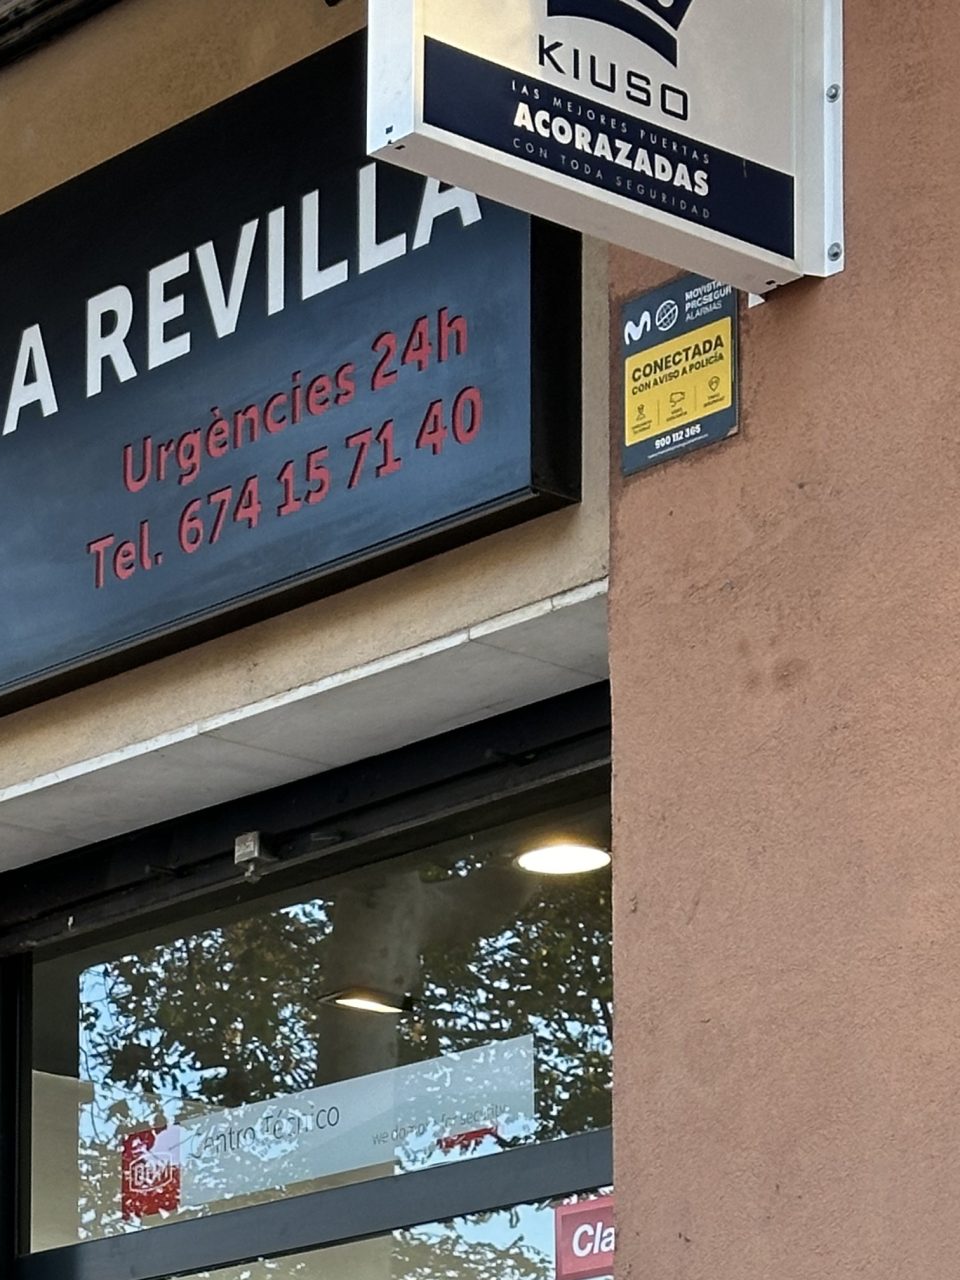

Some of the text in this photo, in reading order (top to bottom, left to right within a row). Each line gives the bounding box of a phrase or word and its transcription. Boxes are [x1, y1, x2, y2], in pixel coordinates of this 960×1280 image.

[538, 34, 688, 121] KIUSO
[513, 102, 709, 196] ACORAZADAS
[553, 96, 628, 134] MEJORES
[640, 129, 710, 165] PUERTAS
[513, 137, 711, 218] CON TODA SEGURIDAD
[86, 161, 482, 399] REVILLA
[685, 280, 723, 301] MOVISTA
[123, 306, 469, 493] Urgències 24h
[631, 334, 724, 382] CONECTADA
[631, 379, 652, 395] CON
[652, 369, 680, 387] AVISO
[681, 366, 688, 377] A
[87, 386, 483, 589] Tel. 674 15 71 40
